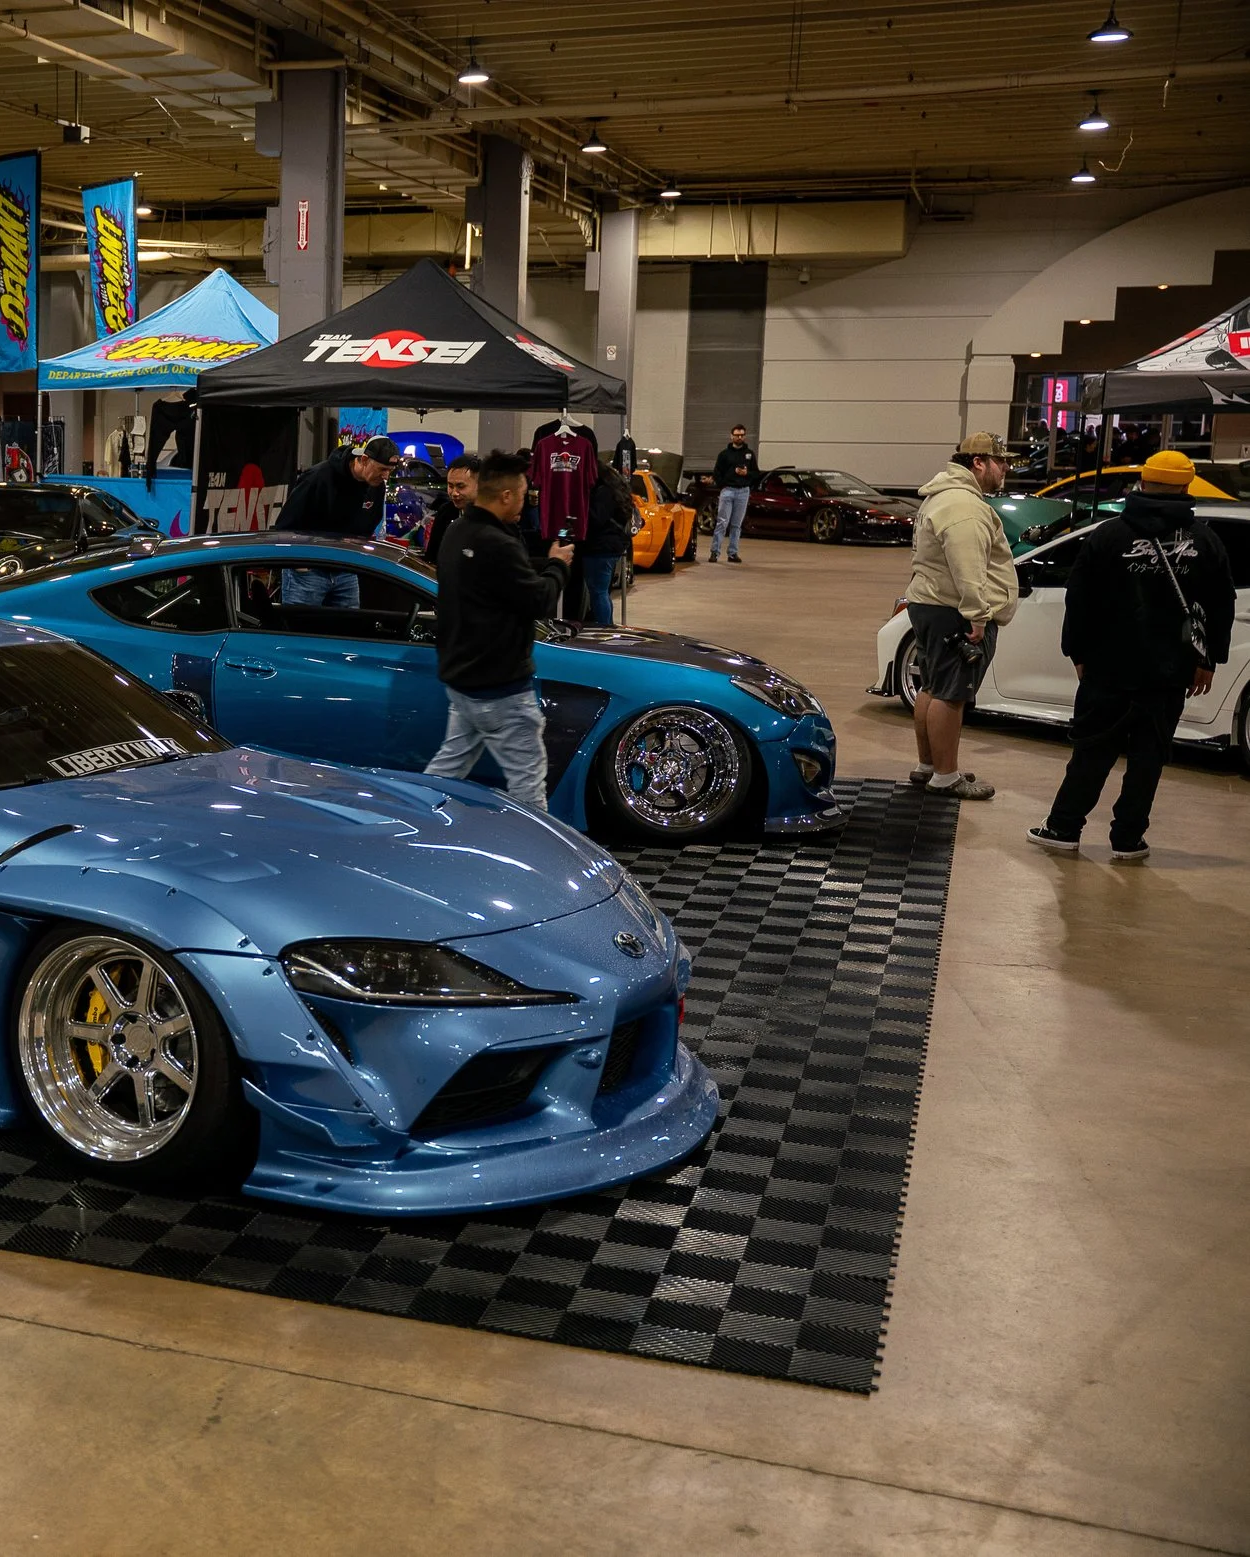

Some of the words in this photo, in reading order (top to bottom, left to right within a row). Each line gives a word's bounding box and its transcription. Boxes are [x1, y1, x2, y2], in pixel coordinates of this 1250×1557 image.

[302, 338, 487, 365] TENSEI
[137, 364, 170, 377] USUAL
[172, 364, 186, 375] OR
